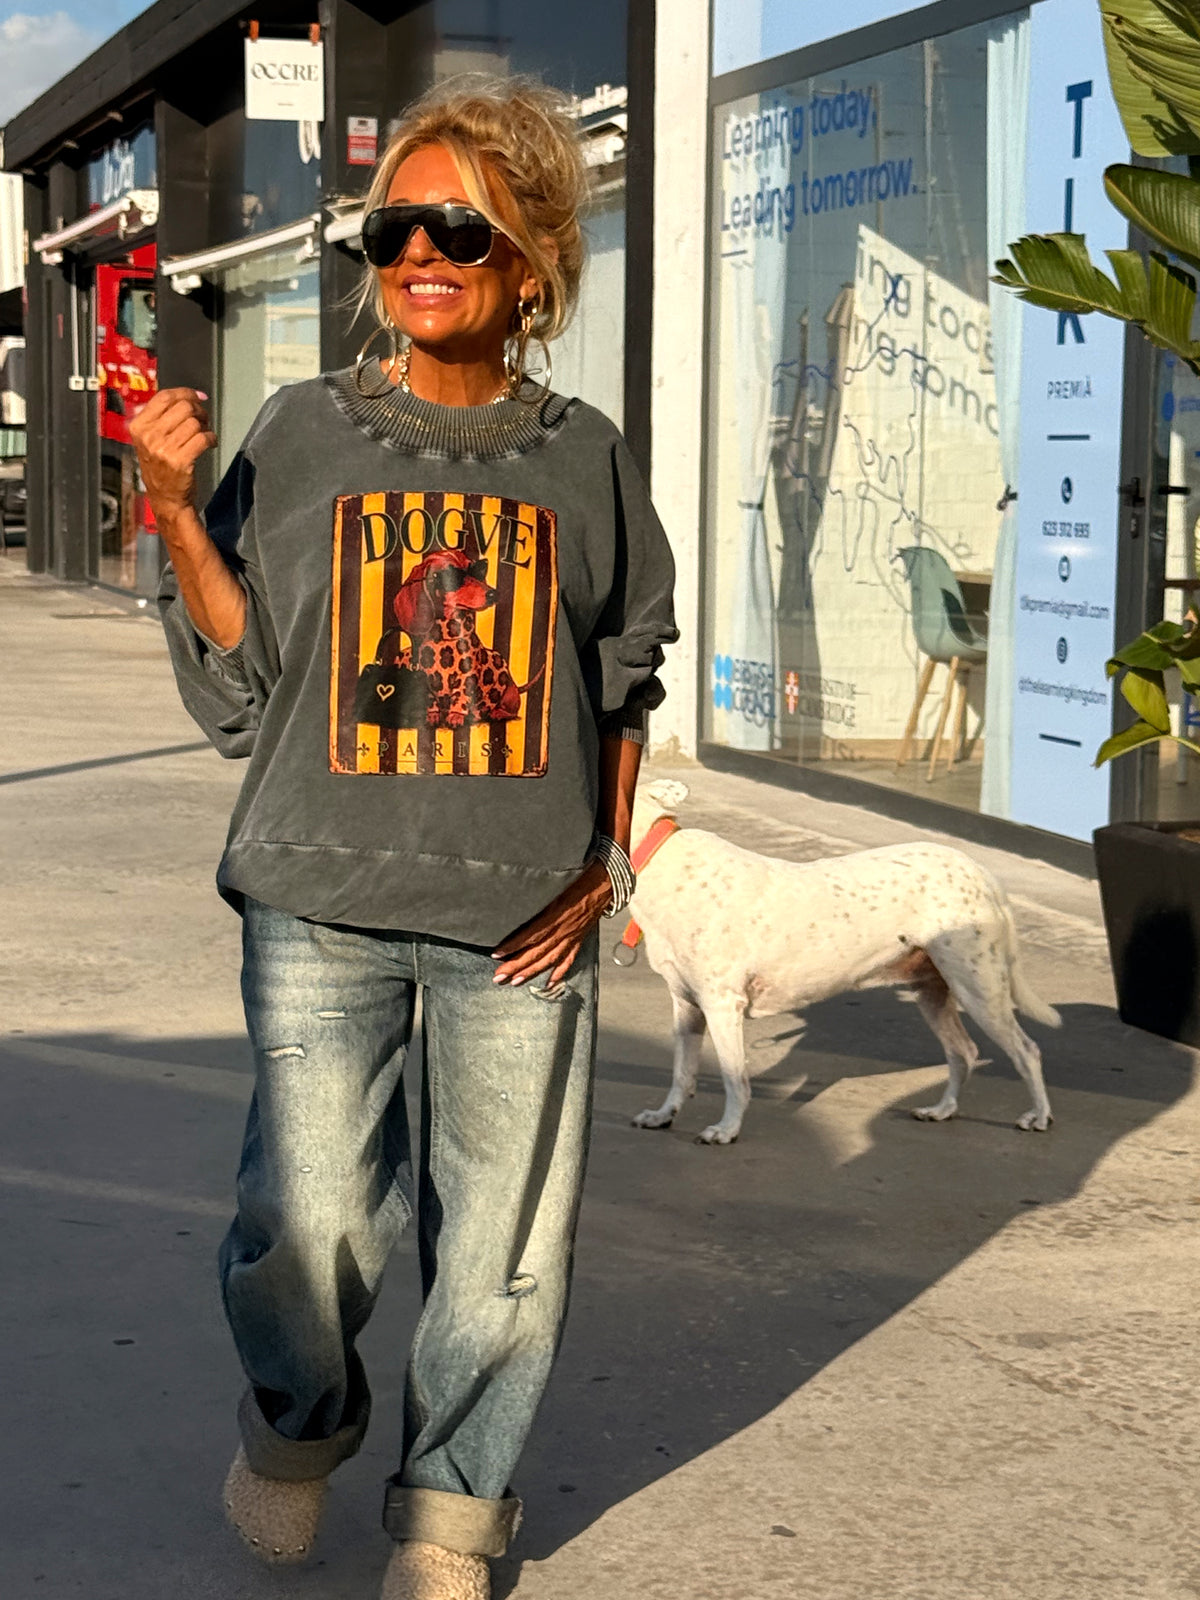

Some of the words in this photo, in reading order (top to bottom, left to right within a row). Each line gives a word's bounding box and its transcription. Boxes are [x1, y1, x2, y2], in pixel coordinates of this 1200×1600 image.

[722, 100, 804, 159] Learning
[721, 176, 796, 232] Leading
[801, 156, 918, 216] tomorrow.
[357, 508, 534, 569] DOGVE
[376, 741, 493, 758] PARIS
